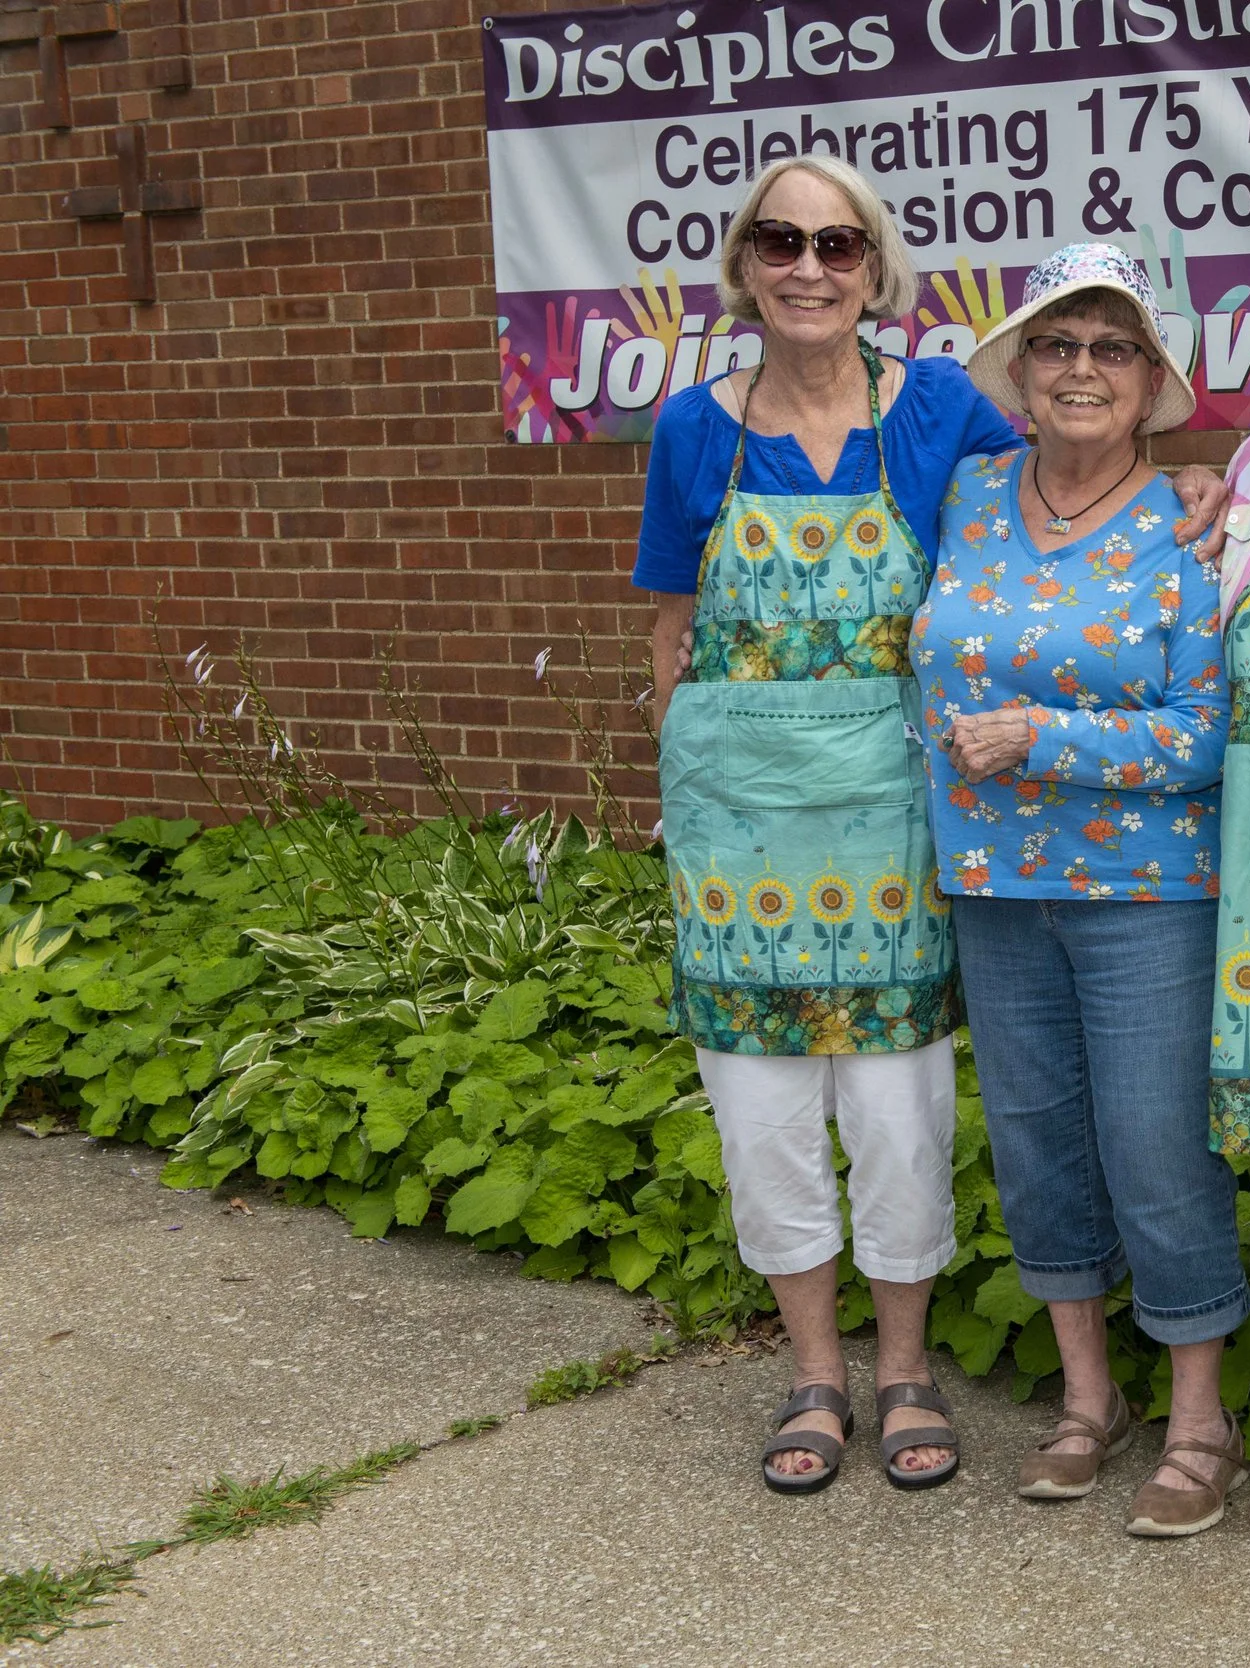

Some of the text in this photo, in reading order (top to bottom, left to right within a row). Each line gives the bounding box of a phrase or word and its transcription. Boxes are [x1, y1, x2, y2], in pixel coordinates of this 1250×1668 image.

[499, 5, 896, 105] Disciples
[655, 100, 1047, 189] Celebrating
[1076, 81, 1201, 156] 175
[626, 178, 1055, 264] Cosion
[1081, 166, 1138, 235] &
